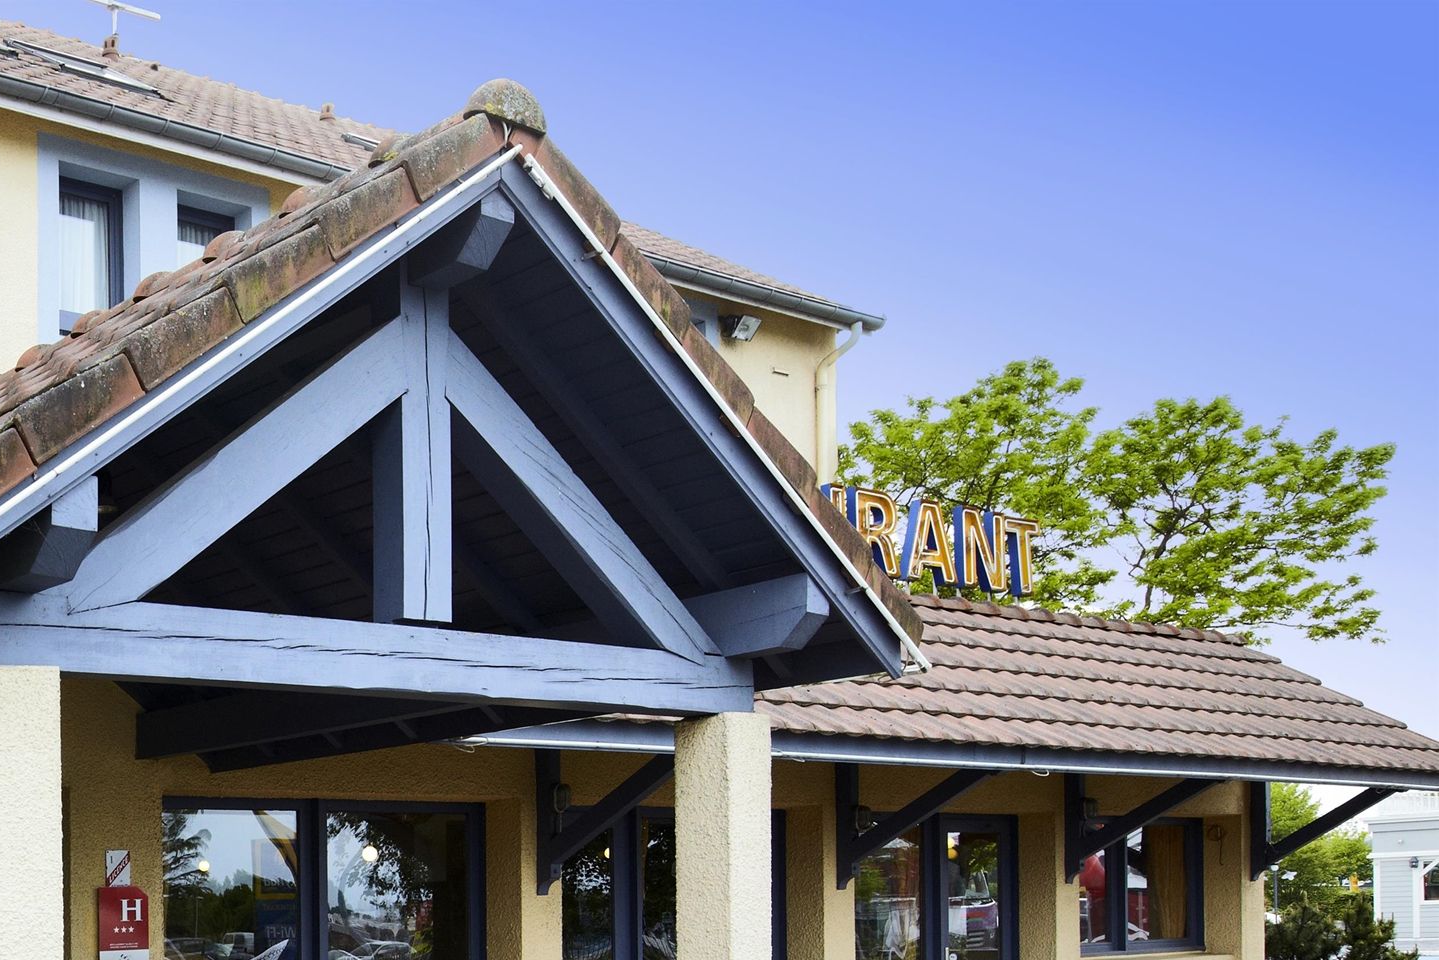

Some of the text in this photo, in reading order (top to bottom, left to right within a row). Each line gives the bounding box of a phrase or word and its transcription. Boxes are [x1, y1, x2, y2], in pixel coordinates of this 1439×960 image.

[821, 483, 1041, 597] RANT
[108, 855, 130, 884] LICENCE
[119, 898, 144, 922] H
